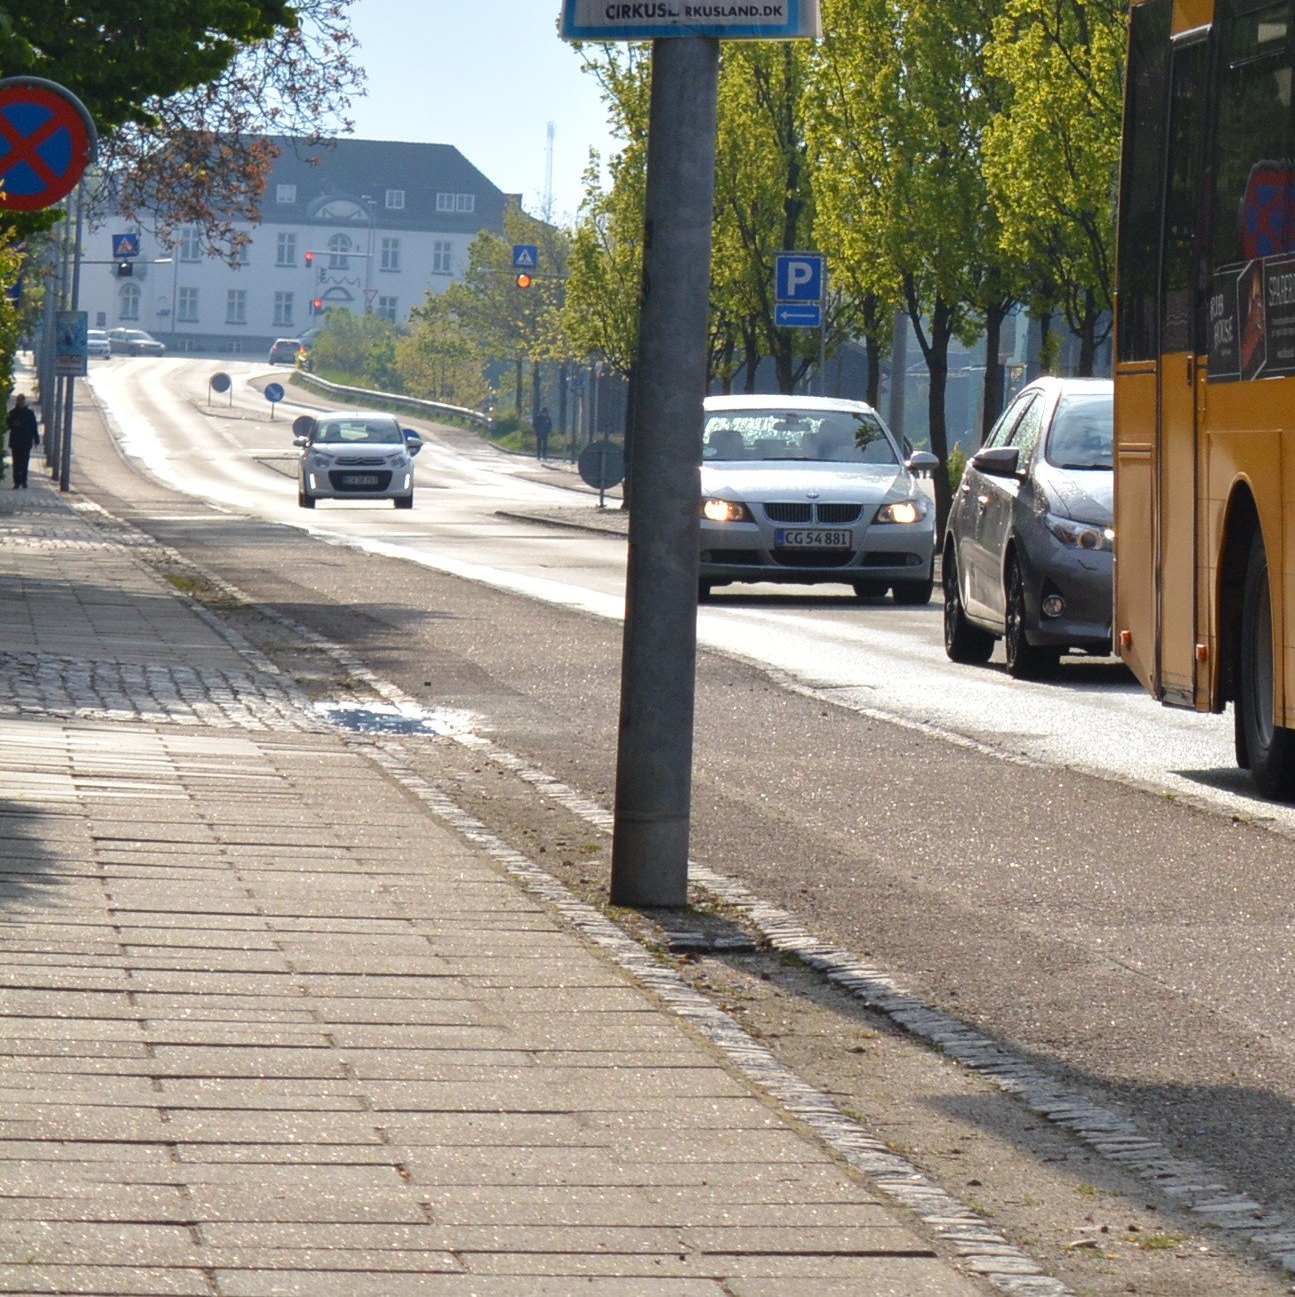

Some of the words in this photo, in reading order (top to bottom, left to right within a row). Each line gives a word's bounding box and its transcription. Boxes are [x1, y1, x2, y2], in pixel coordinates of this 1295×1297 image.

[787, 261, 812, 296] P
[1209, 292, 1224, 321] RIB
[785, 532, 804, 544] CG
[806, 532, 823, 544] 54
[824, 532, 847, 545] 881
